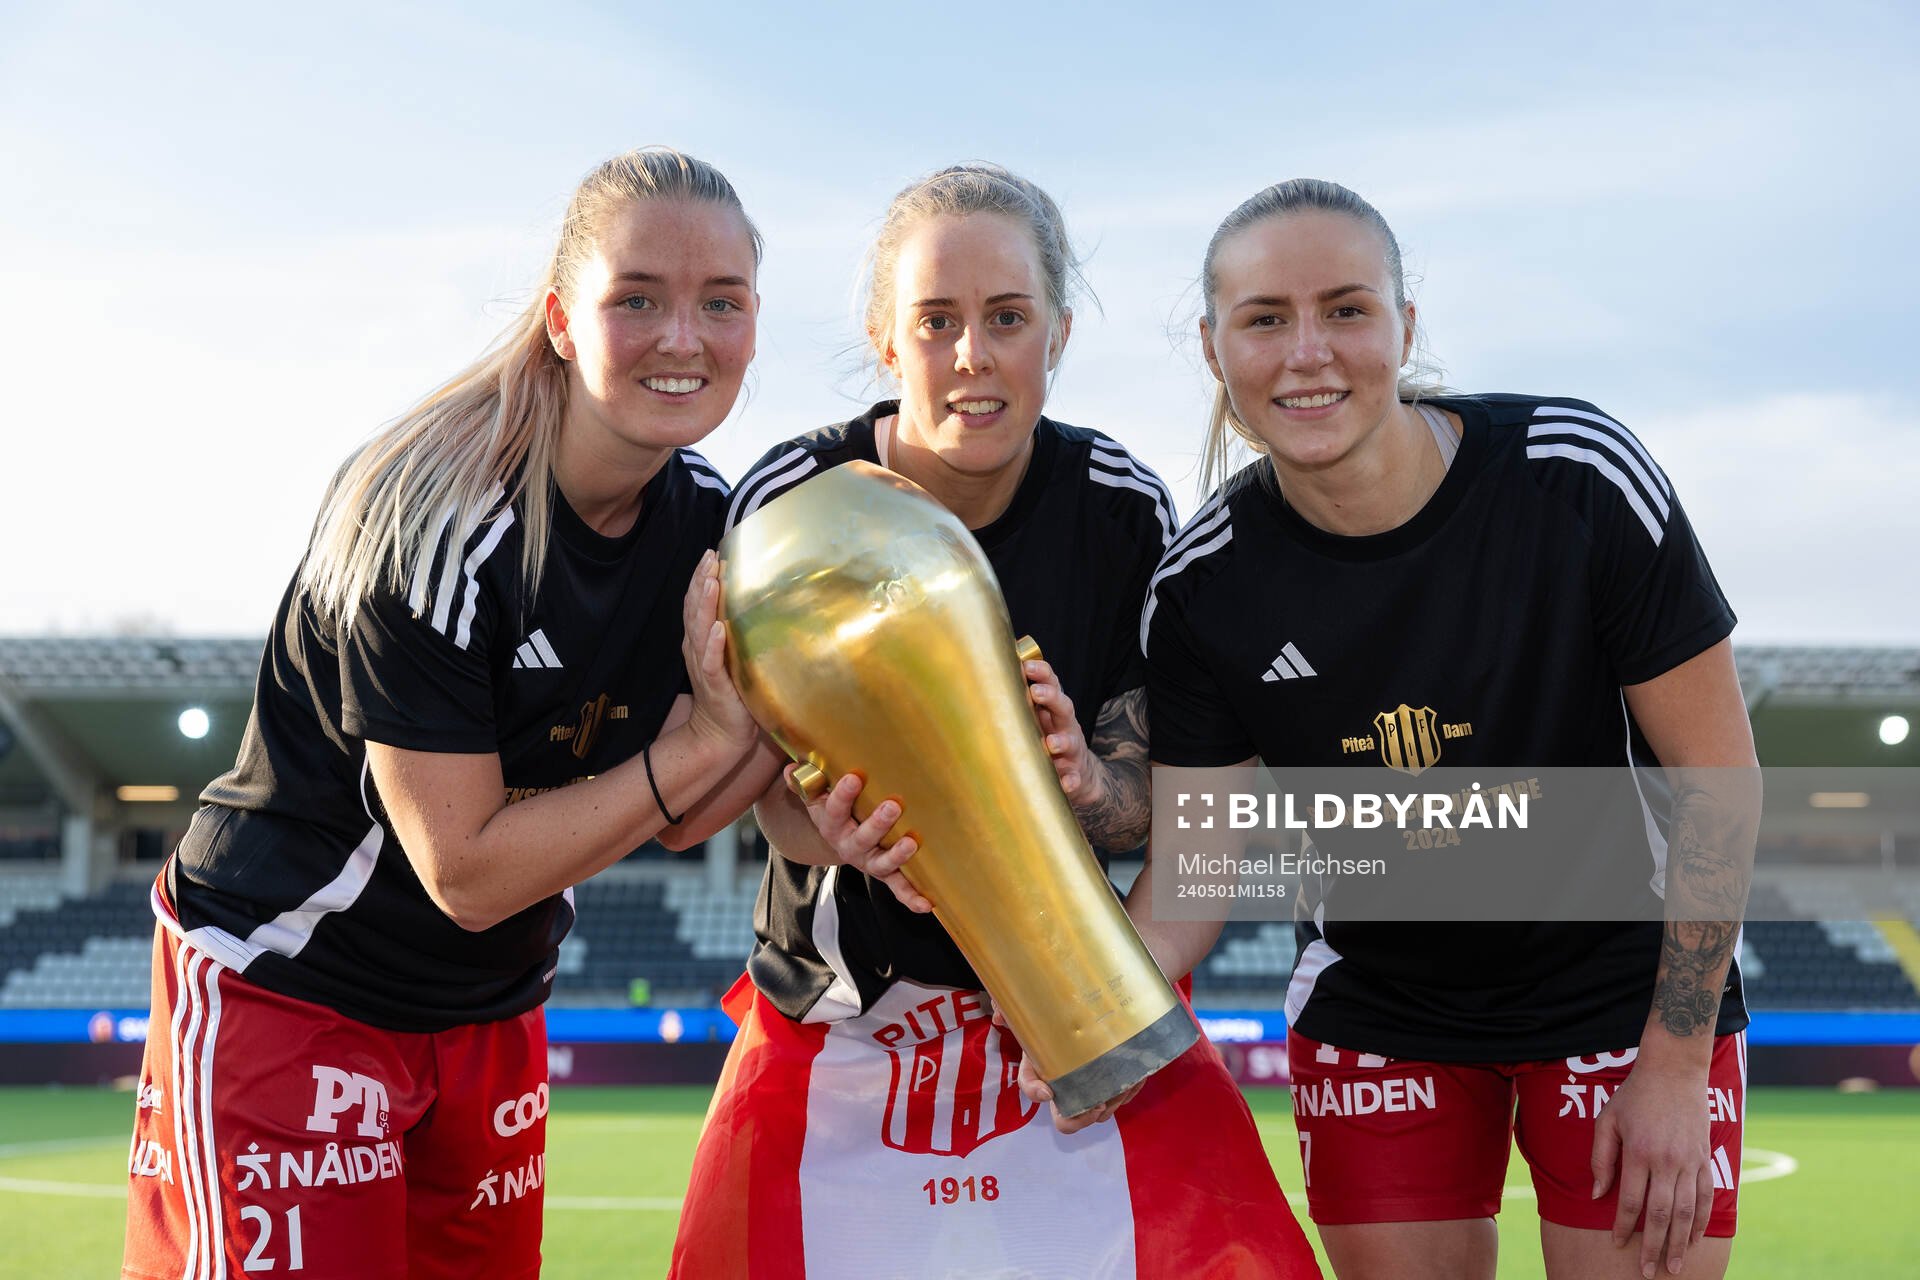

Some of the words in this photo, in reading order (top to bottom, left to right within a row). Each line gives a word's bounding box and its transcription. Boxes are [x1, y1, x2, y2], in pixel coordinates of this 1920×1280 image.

[1341, 734, 1375, 754] Piteå
[1442, 721, 1473, 740] Dam
[1402, 828, 1461, 851] 2024
[1301, 1077, 1436, 1117] NÅIDEN
[280, 1140, 403, 1189] NÅIDEN
[923, 1175, 999, 1205] 1918
[240, 1205, 303, 1271] 21
